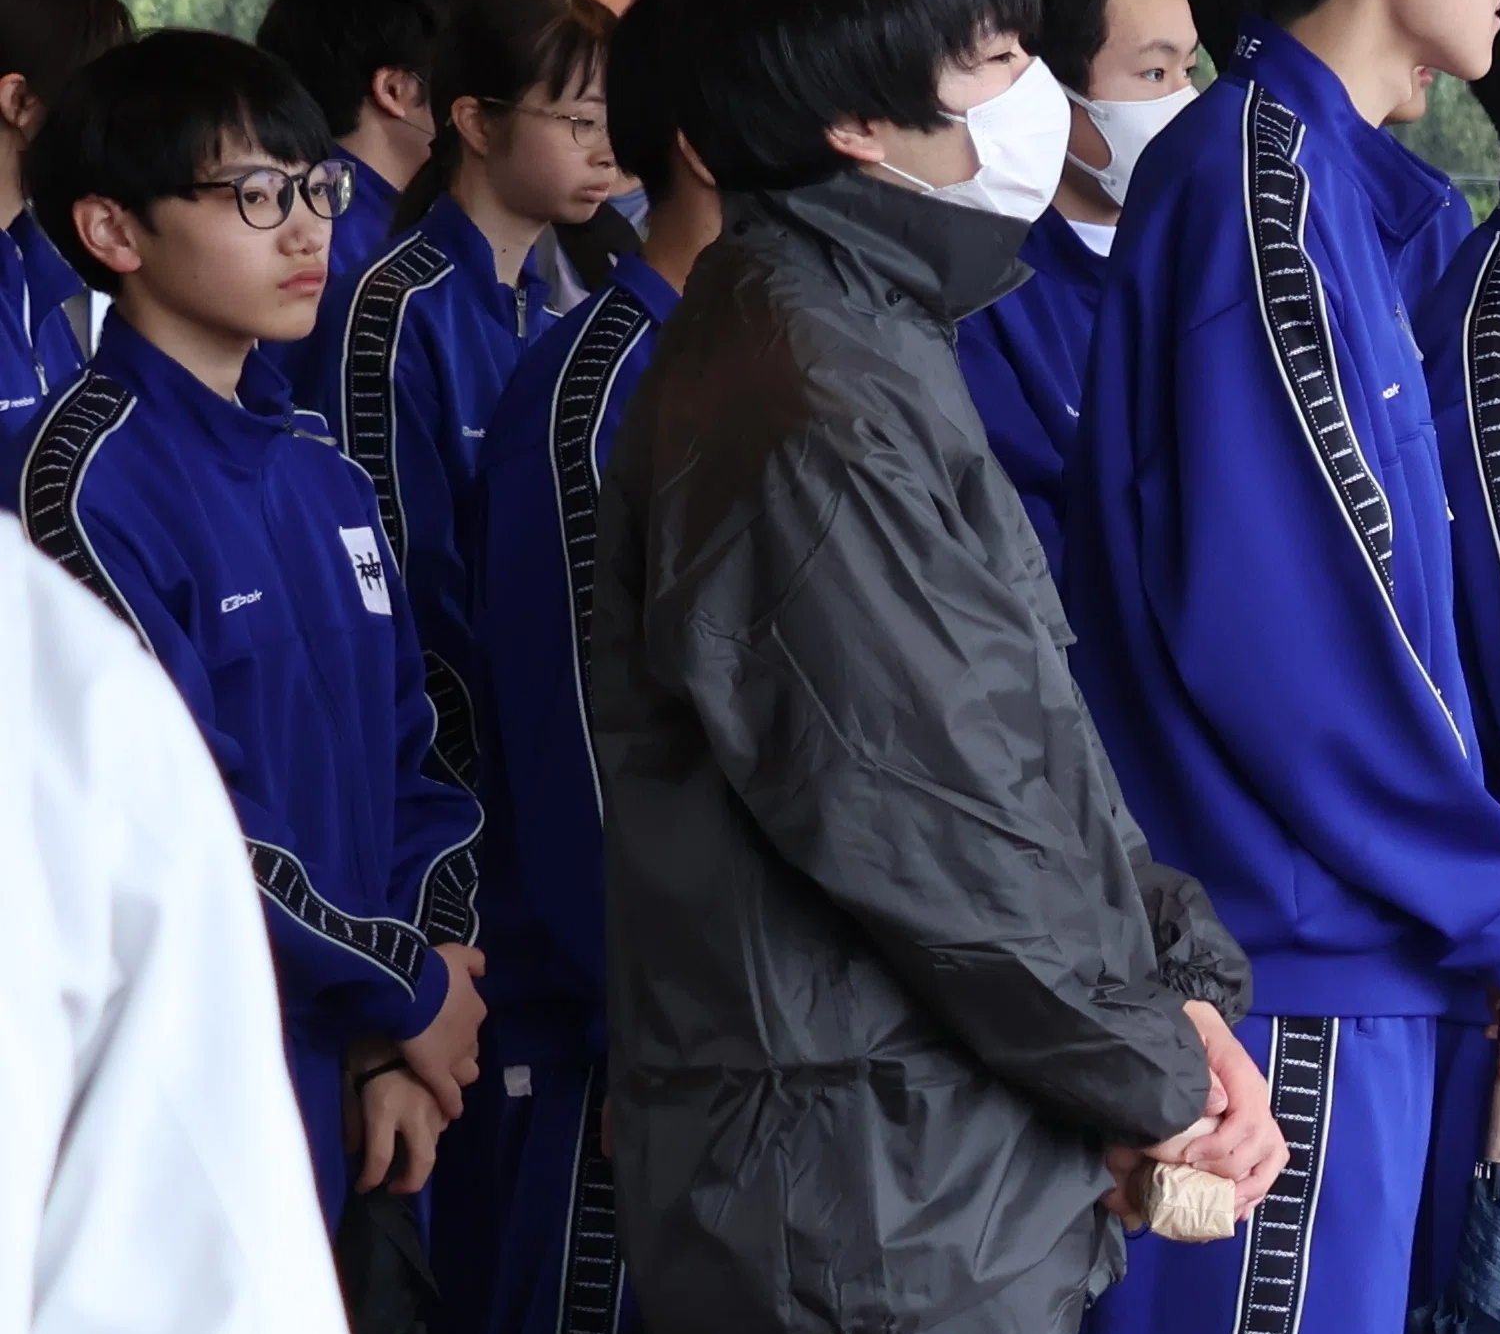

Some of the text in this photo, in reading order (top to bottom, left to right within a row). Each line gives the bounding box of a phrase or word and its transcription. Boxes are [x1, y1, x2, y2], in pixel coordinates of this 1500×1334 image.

[1284, 1031, 1323, 1042] reebok
[1282, 1057, 1320, 1069] reebok
[1279, 1084, 1318, 1096] reebok
[1276, 1112, 1316, 1123] reebok
[1266, 1193, 1305, 1204] reebok
[1260, 1220, 1301, 1231] reebok
[1256, 1248, 1298, 1258] reebok
[1253, 1276, 1295, 1285] reebok
[1249, 1303, 1290, 1313] reebok
